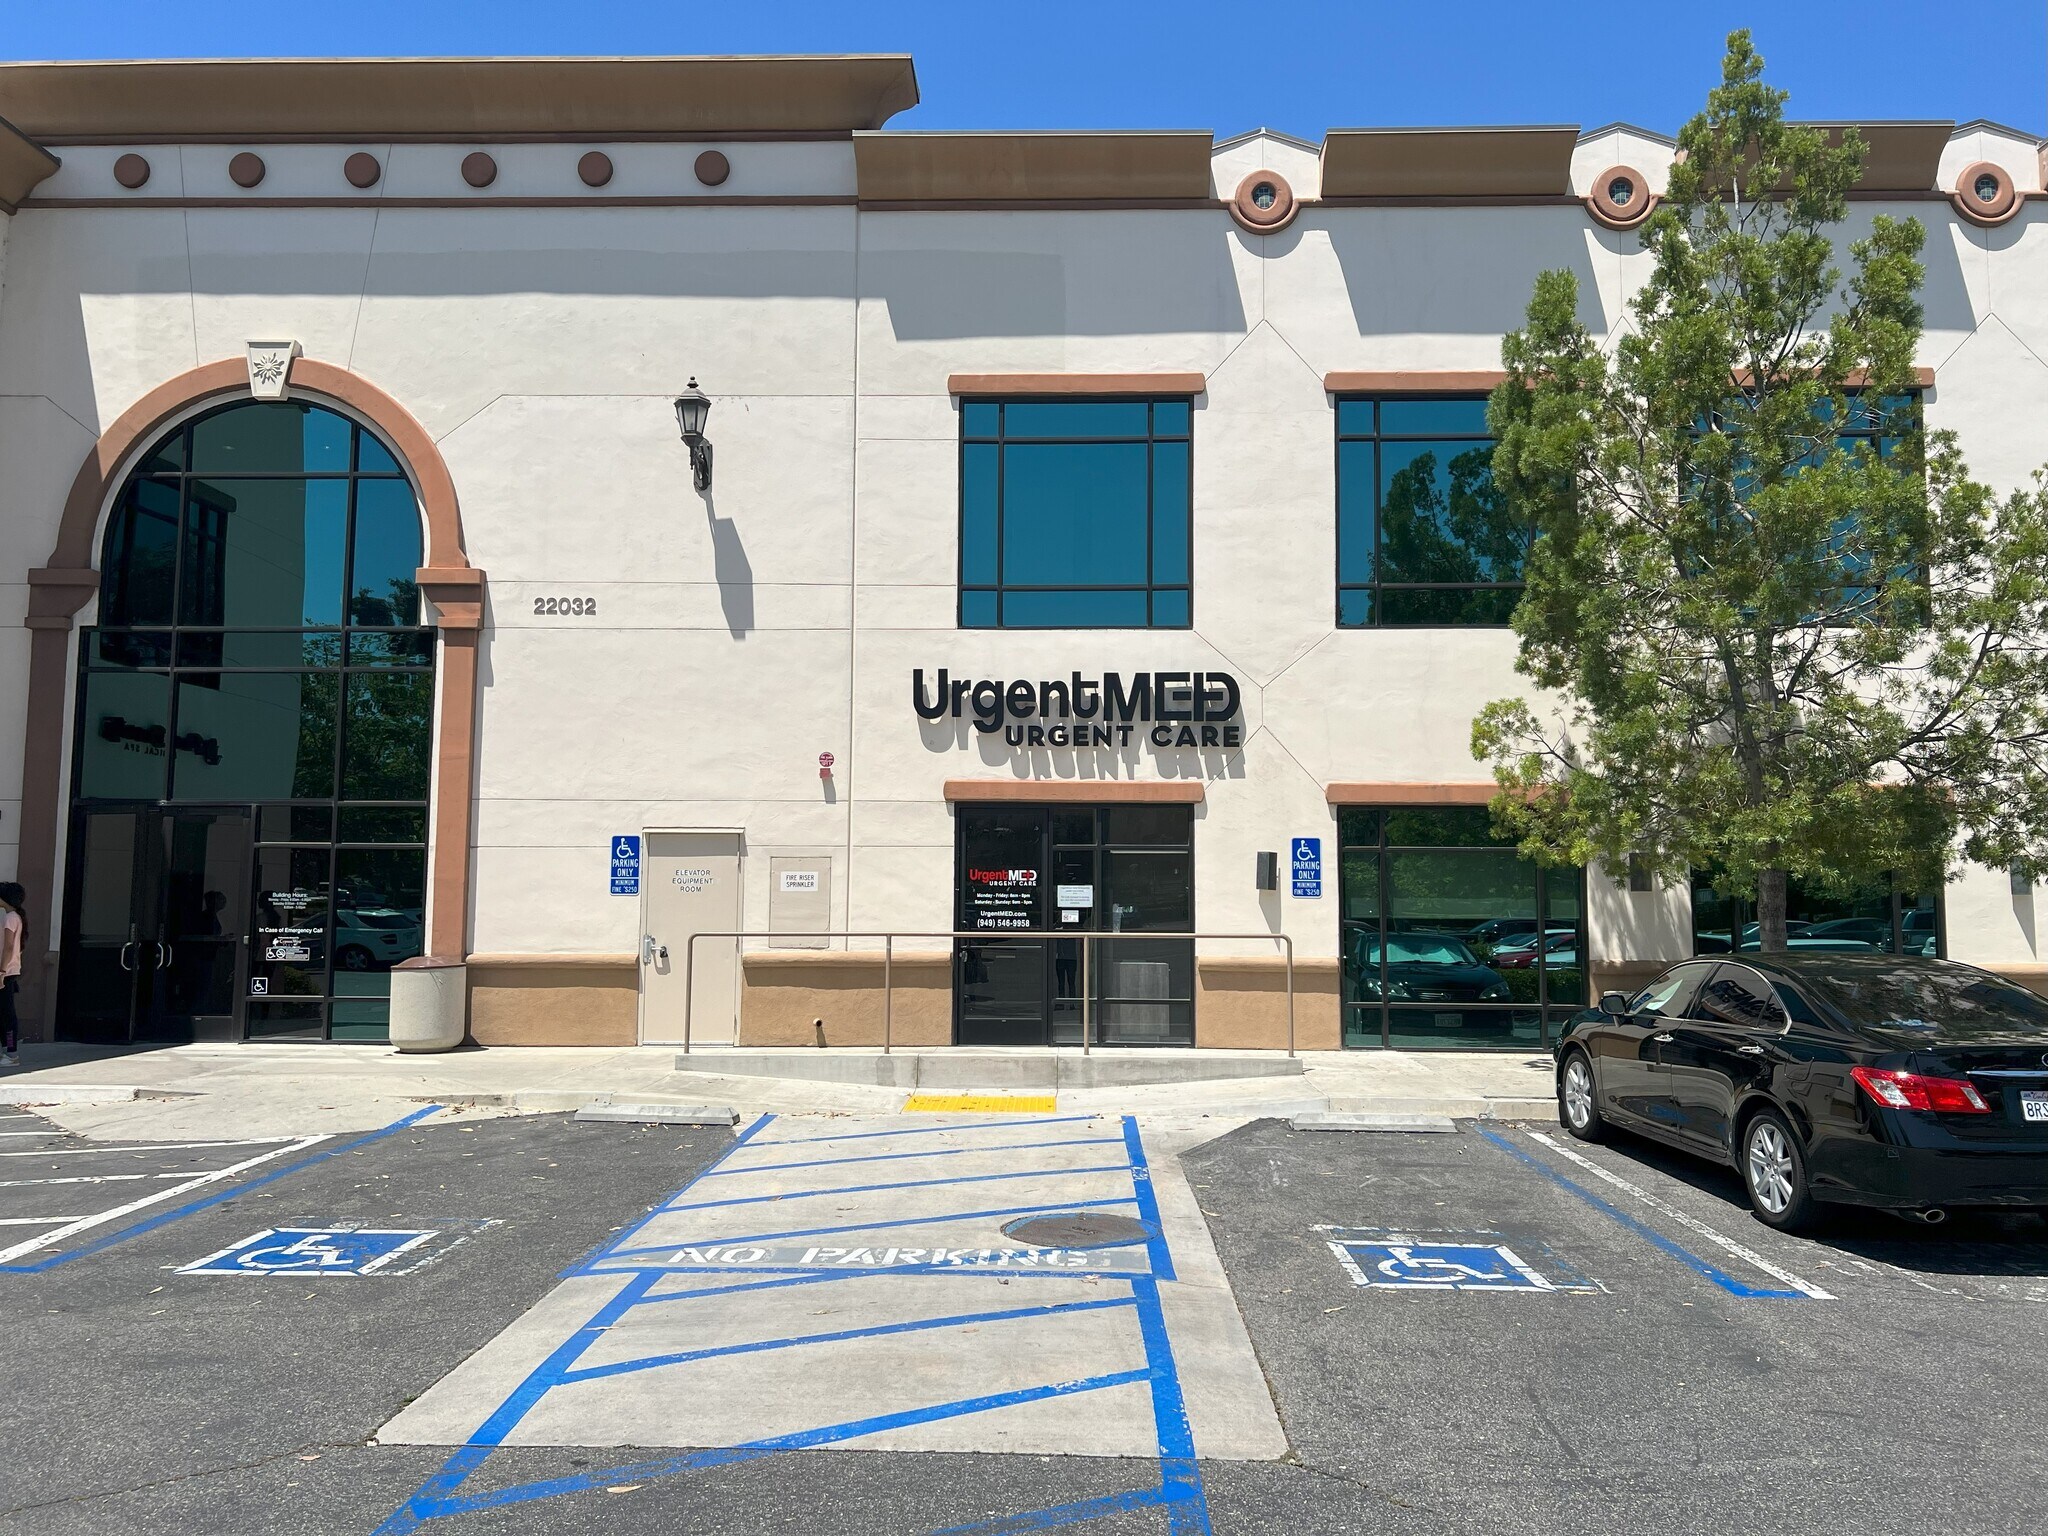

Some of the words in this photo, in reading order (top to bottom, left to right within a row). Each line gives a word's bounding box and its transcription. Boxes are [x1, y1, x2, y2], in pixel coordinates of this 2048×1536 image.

[533, 597, 597, 616] 22032
[913, 669, 1241, 733] UrgentMED
[1005, 725, 1134, 747] URGENT
[1150, 725, 1240, 748] CARE
[612, 859, 639, 868] PARKING
[1294, 861, 1320, 870] PARKING
[617, 868, 634, 877] ONLY
[970, 869, 1037, 883] UrgentMED
[1299, 871, 1315, 879] ONLY
[977, 919, 996, 928] (949)
[997, 919, 1030, 927] 546-9958
[667, 1247, 771, 1263] NO
[799, 1247, 1088, 1267] PARKING
